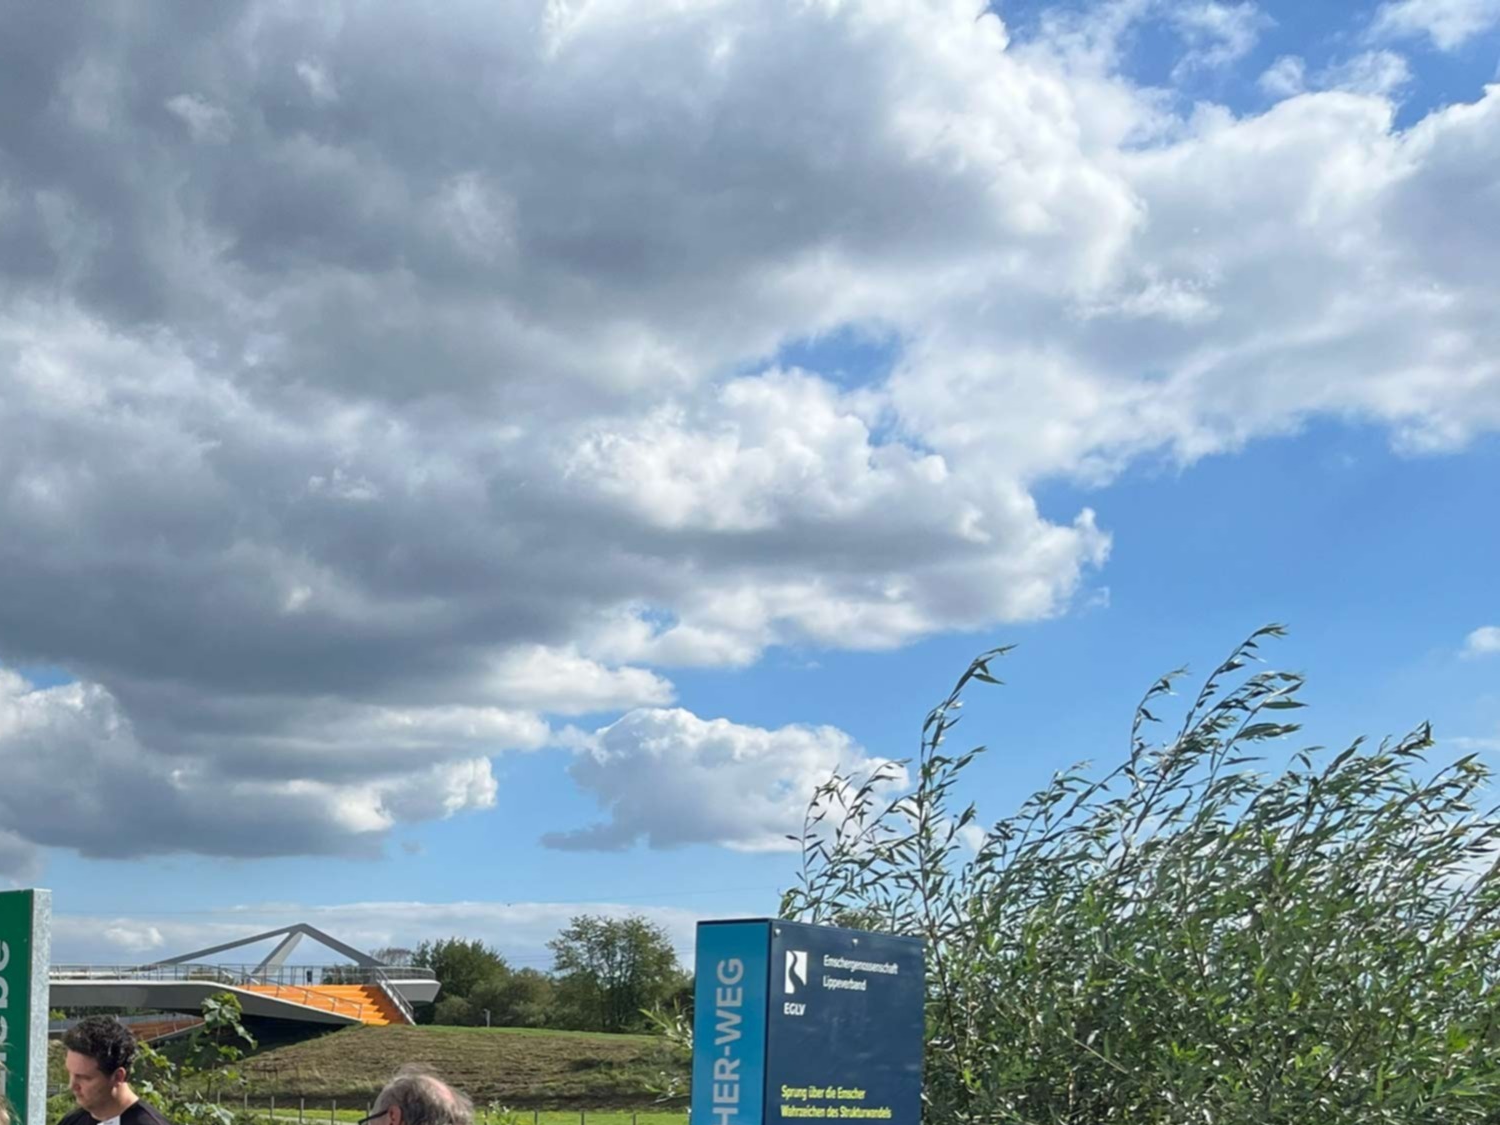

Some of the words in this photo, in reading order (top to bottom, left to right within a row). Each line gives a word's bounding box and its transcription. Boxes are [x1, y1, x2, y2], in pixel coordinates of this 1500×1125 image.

[823, 954, 899, 975] Emschergenossenschaft
[823, 975, 867, 991] Lippeverband
[783, 1002, 806, 1016] EGLV
[781, 1085, 807, 1101] Sprung
[808, 1086, 825, 1099] über
[825, 1086, 837, 1099] die
[837, 1086, 866, 1100] Emscher
[781, 1105, 825, 1117] Wahrzeichen
[826, 1106, 839, 1118] des
[840, 1105, 892, 1119] Strukturwandels
